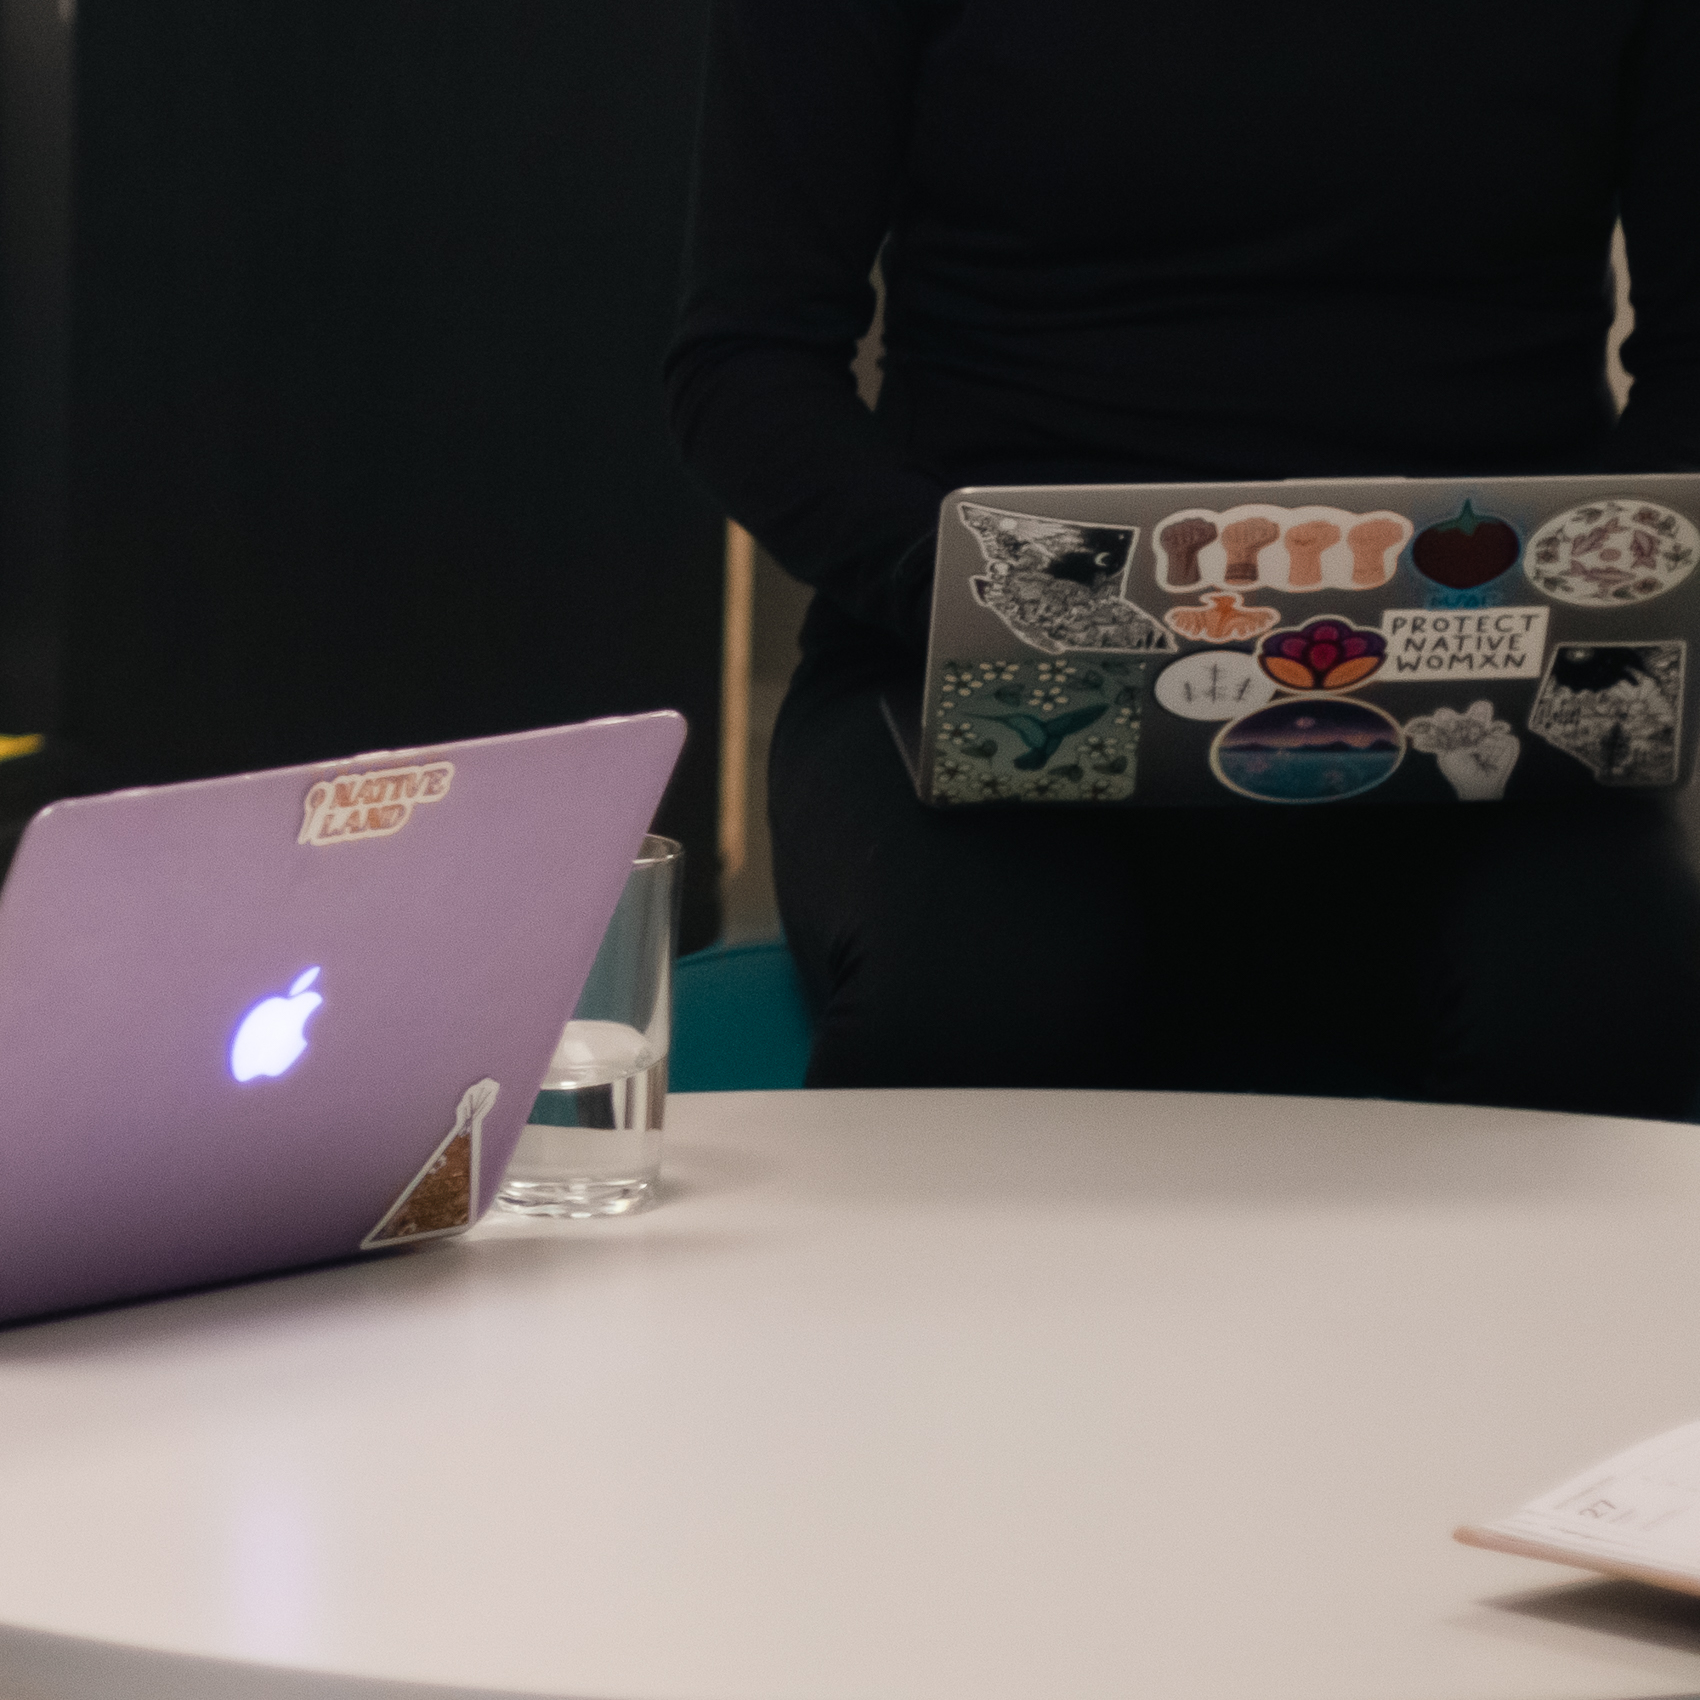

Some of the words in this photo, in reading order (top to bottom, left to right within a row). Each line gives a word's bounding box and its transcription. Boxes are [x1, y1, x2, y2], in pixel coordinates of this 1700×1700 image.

[1392, 614, 1540, 635] PROTECT
[1405, 633, 1523, 652] NATIVE
[1397, 653, 1526, 672] WOMXN
[332, 769, 449, 808] NATIVE
[318, 804, 406, 839] LAND
